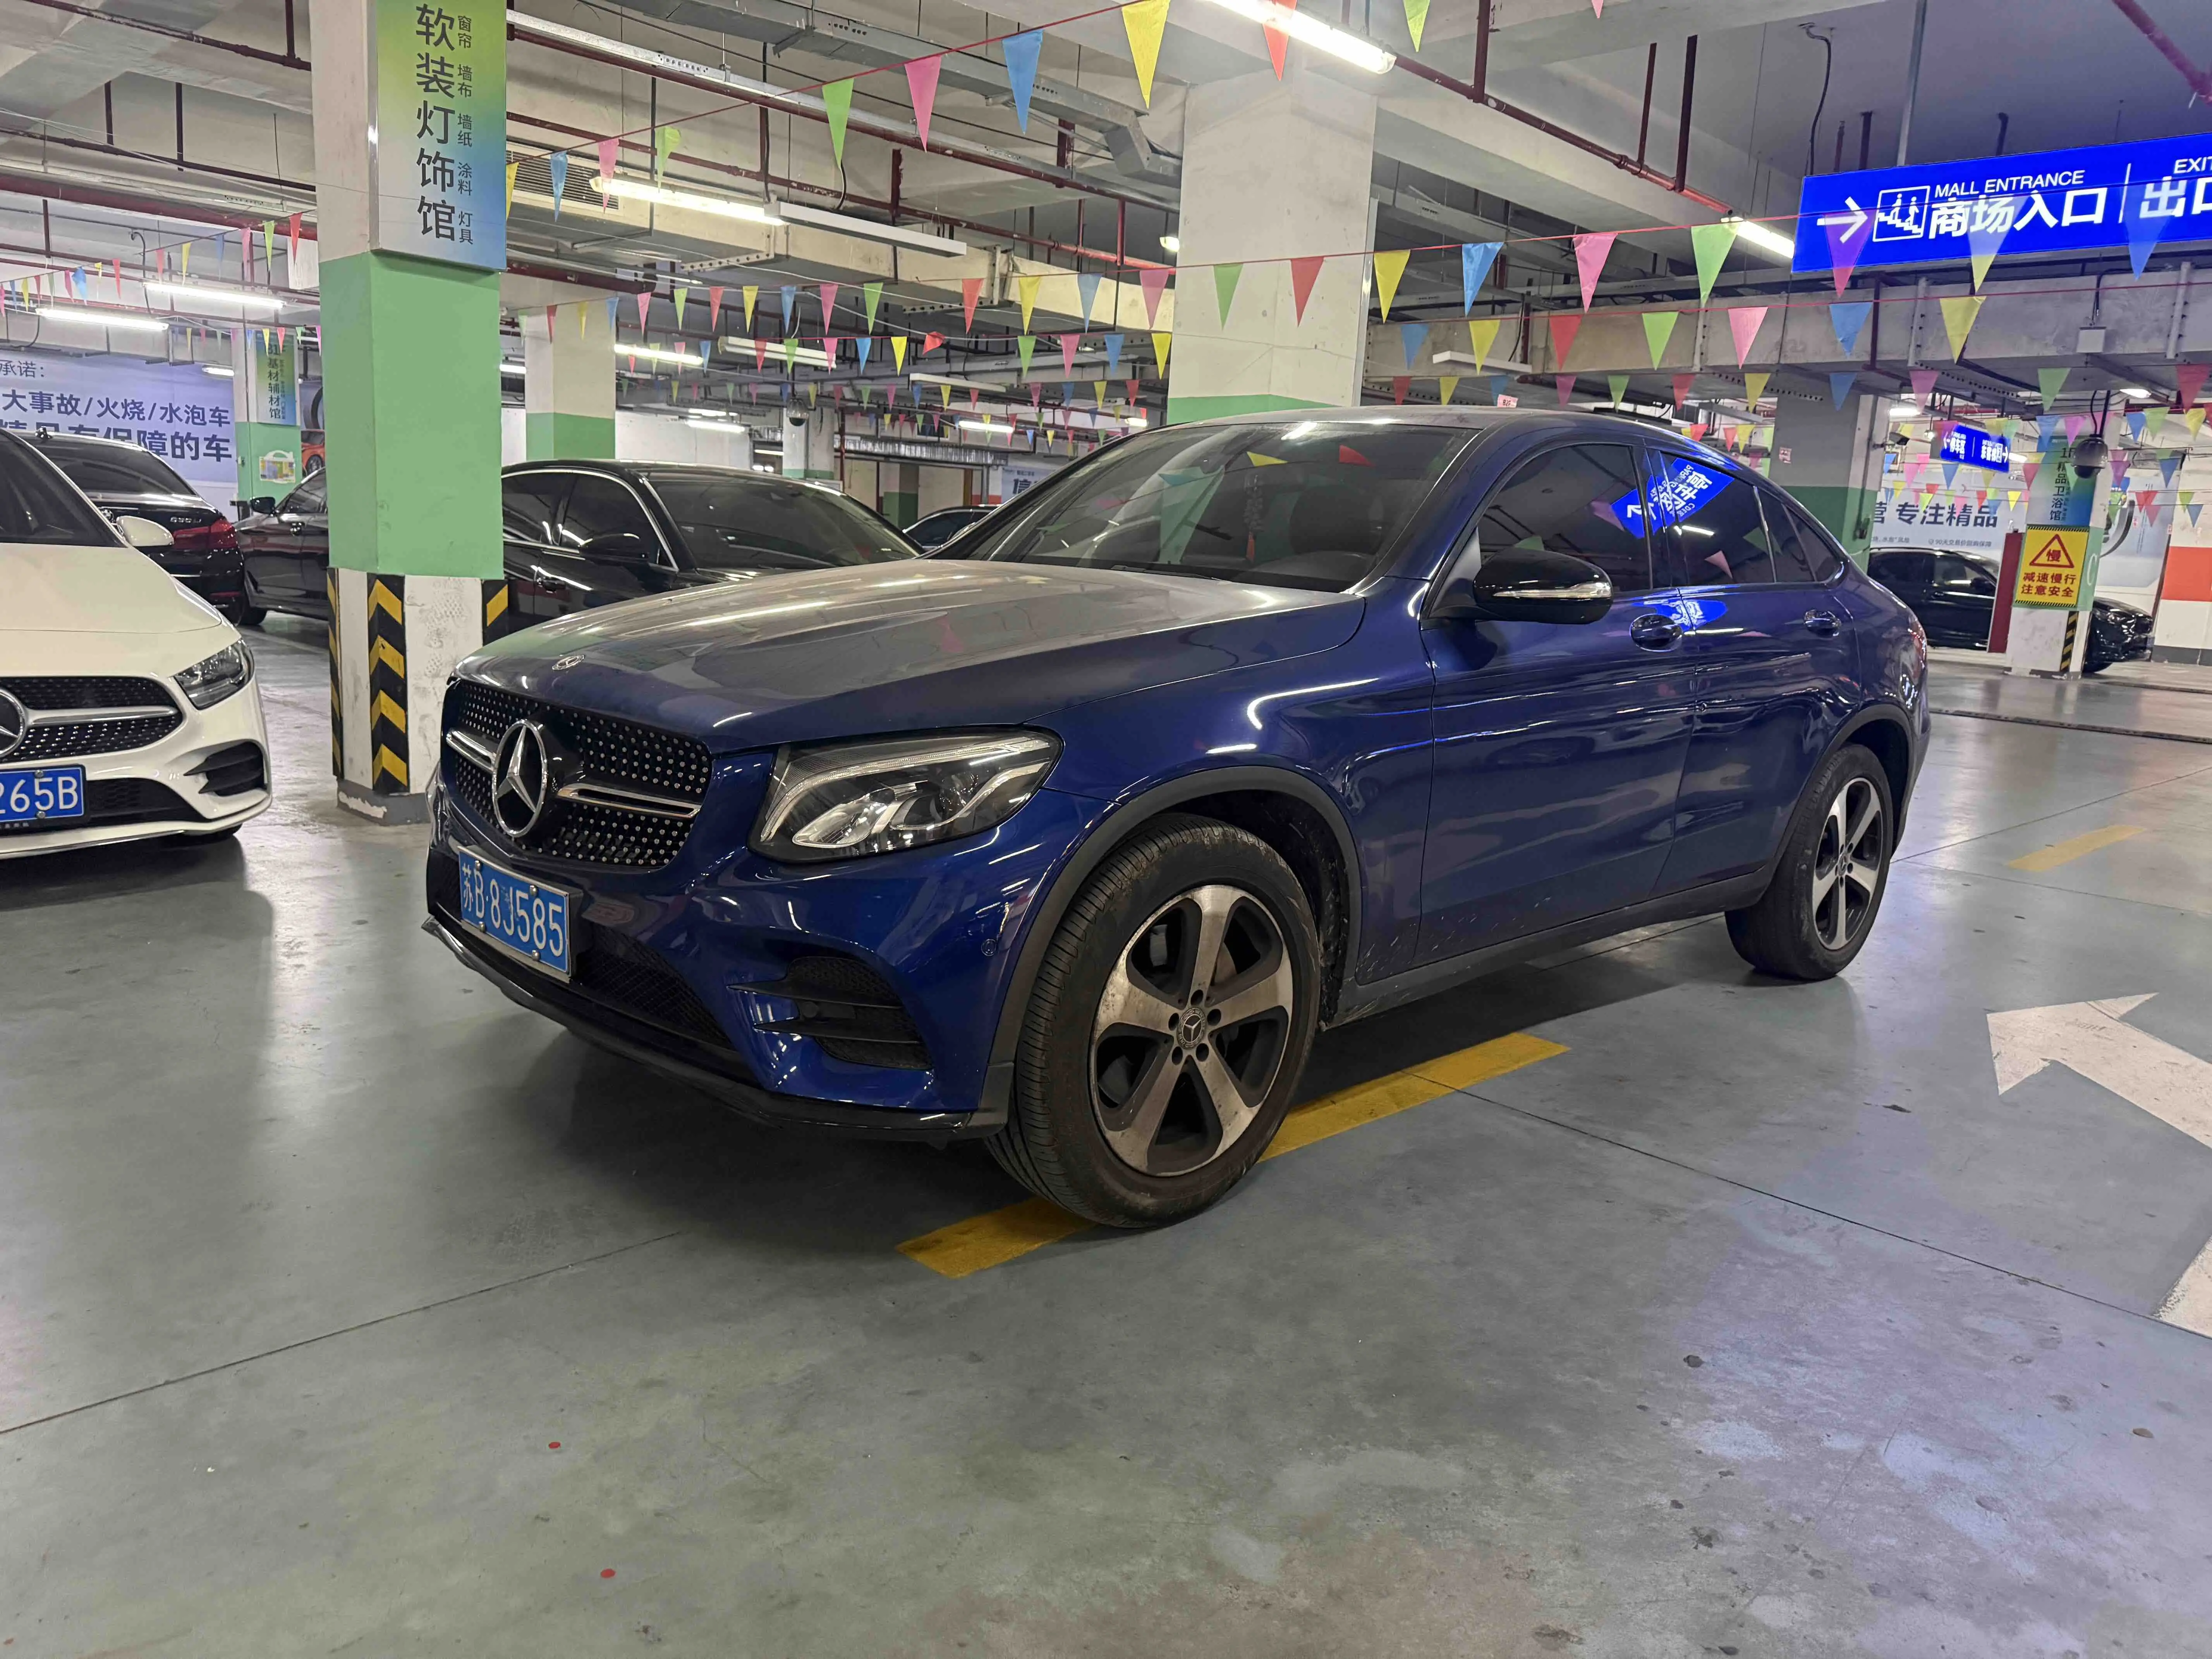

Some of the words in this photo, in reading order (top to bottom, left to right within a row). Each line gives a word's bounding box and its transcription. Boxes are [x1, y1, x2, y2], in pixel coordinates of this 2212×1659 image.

[458, 15, 472, 48] 窗帘
[458, 64, 472, 98] 墙布
[416, 3, 455, 241] 软装灯饰馆
[458, 113, 472, 148] 墙纸
[458, 162, 472, 196] 涂料
[1934, 181, 1979, 198] MALL
[1984, 170, 2085, 193] ENTRANCE
[459, 211, 473, 245] 灯具
[1929, 187, 2107, 239] 商场入口
[1, 389, 231, 427] 大事故/火烧/水泡车
[1896, 502, 1997, 527] 专注精品
[2046, 549, 2061, 562] 慢
[2021, 584, 2074, 597] 注意安全
[2023, 572, 2076, 584] 减速慢行
[0, 776, 78, 814] 65B
